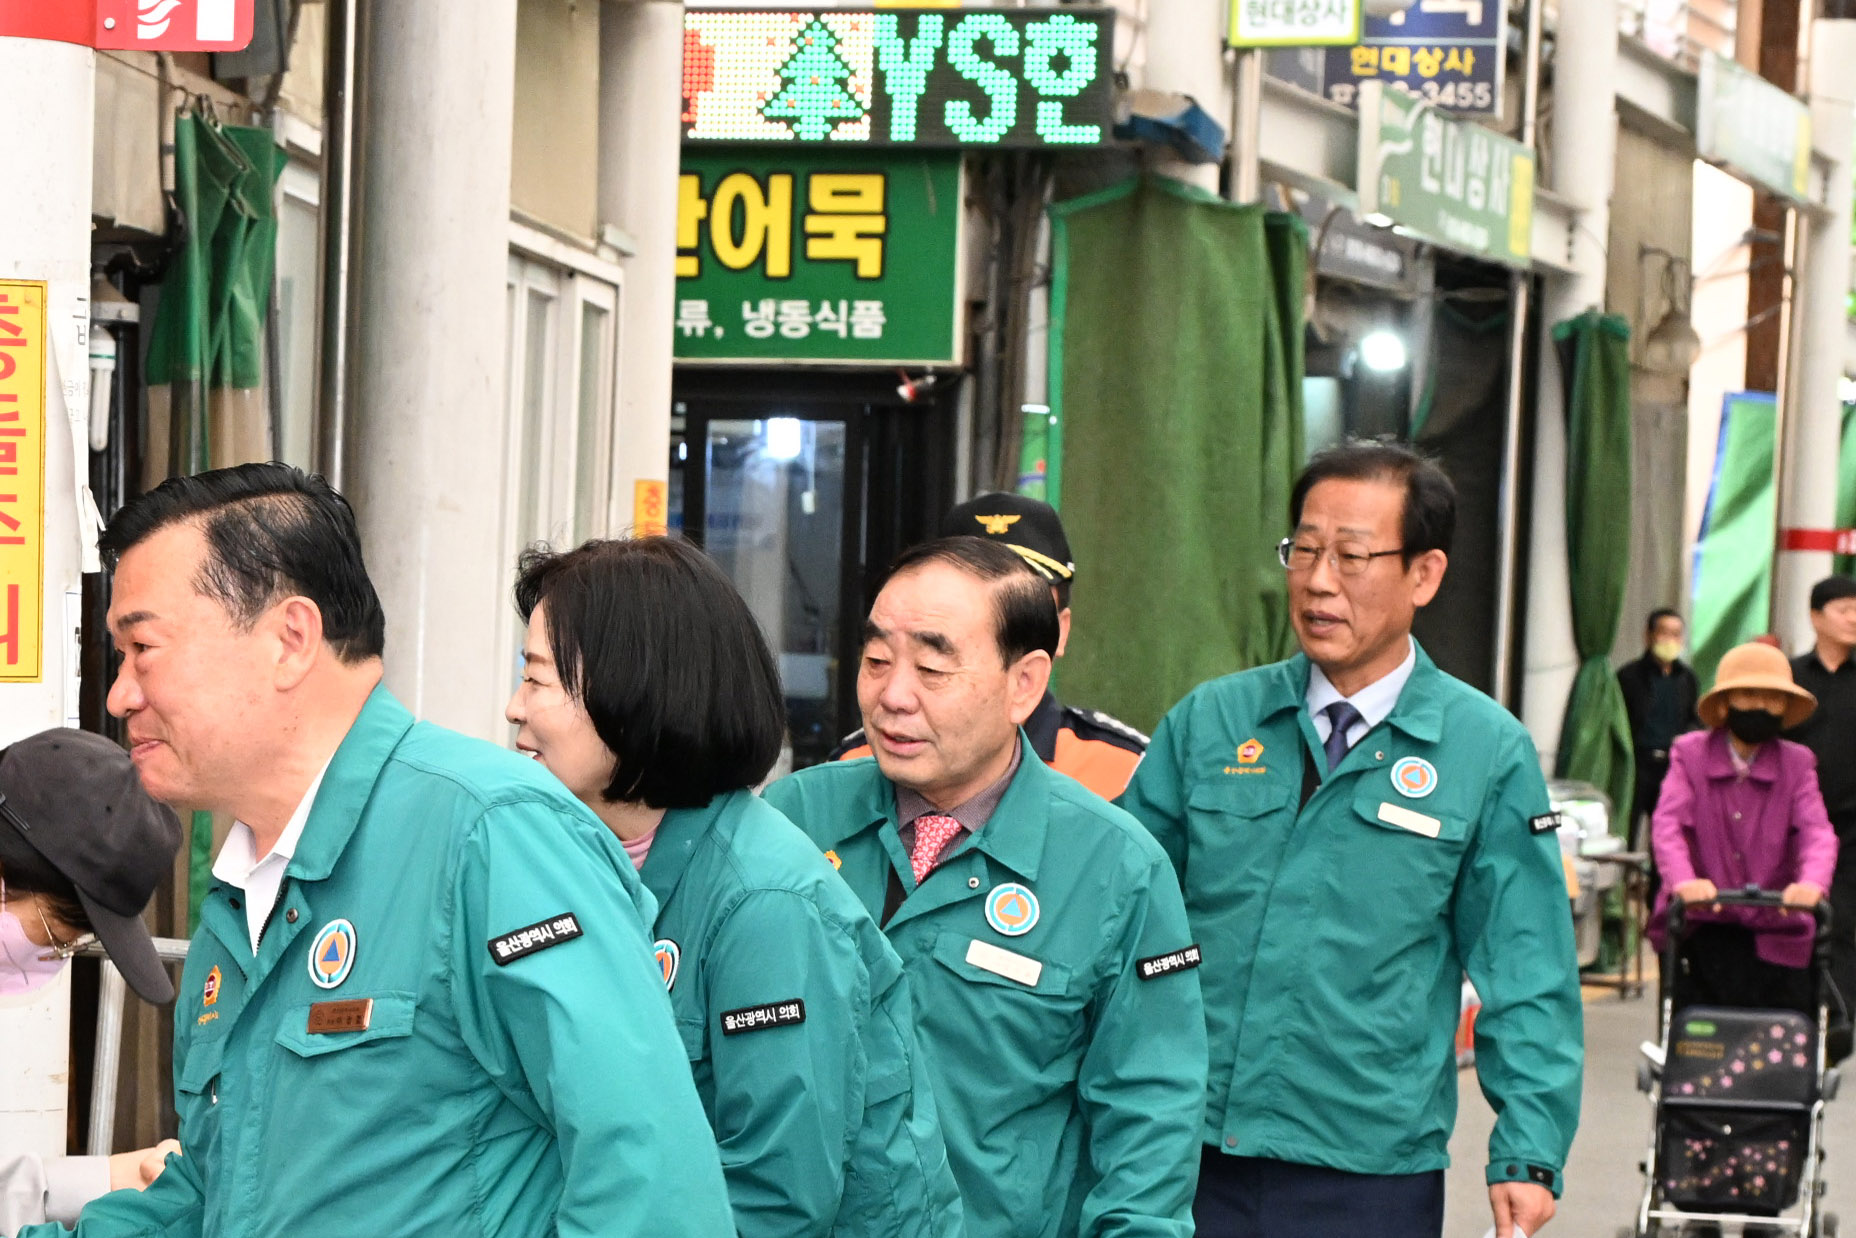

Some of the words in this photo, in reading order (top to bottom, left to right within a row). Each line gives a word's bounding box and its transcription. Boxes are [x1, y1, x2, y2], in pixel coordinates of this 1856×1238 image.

[1350, 46, 1476, 78] 현대상사
[741, 298, 887, 339] 냉동식품
[496, 924, 555, 957] 울산광역시
[553, 916, 578, 935] 의회
[1144, 952, 1185, 976] 울산광역시
[725, 1007, 777, 1030] 울산광역시
[779, 1003, 801, 1020] 의회
